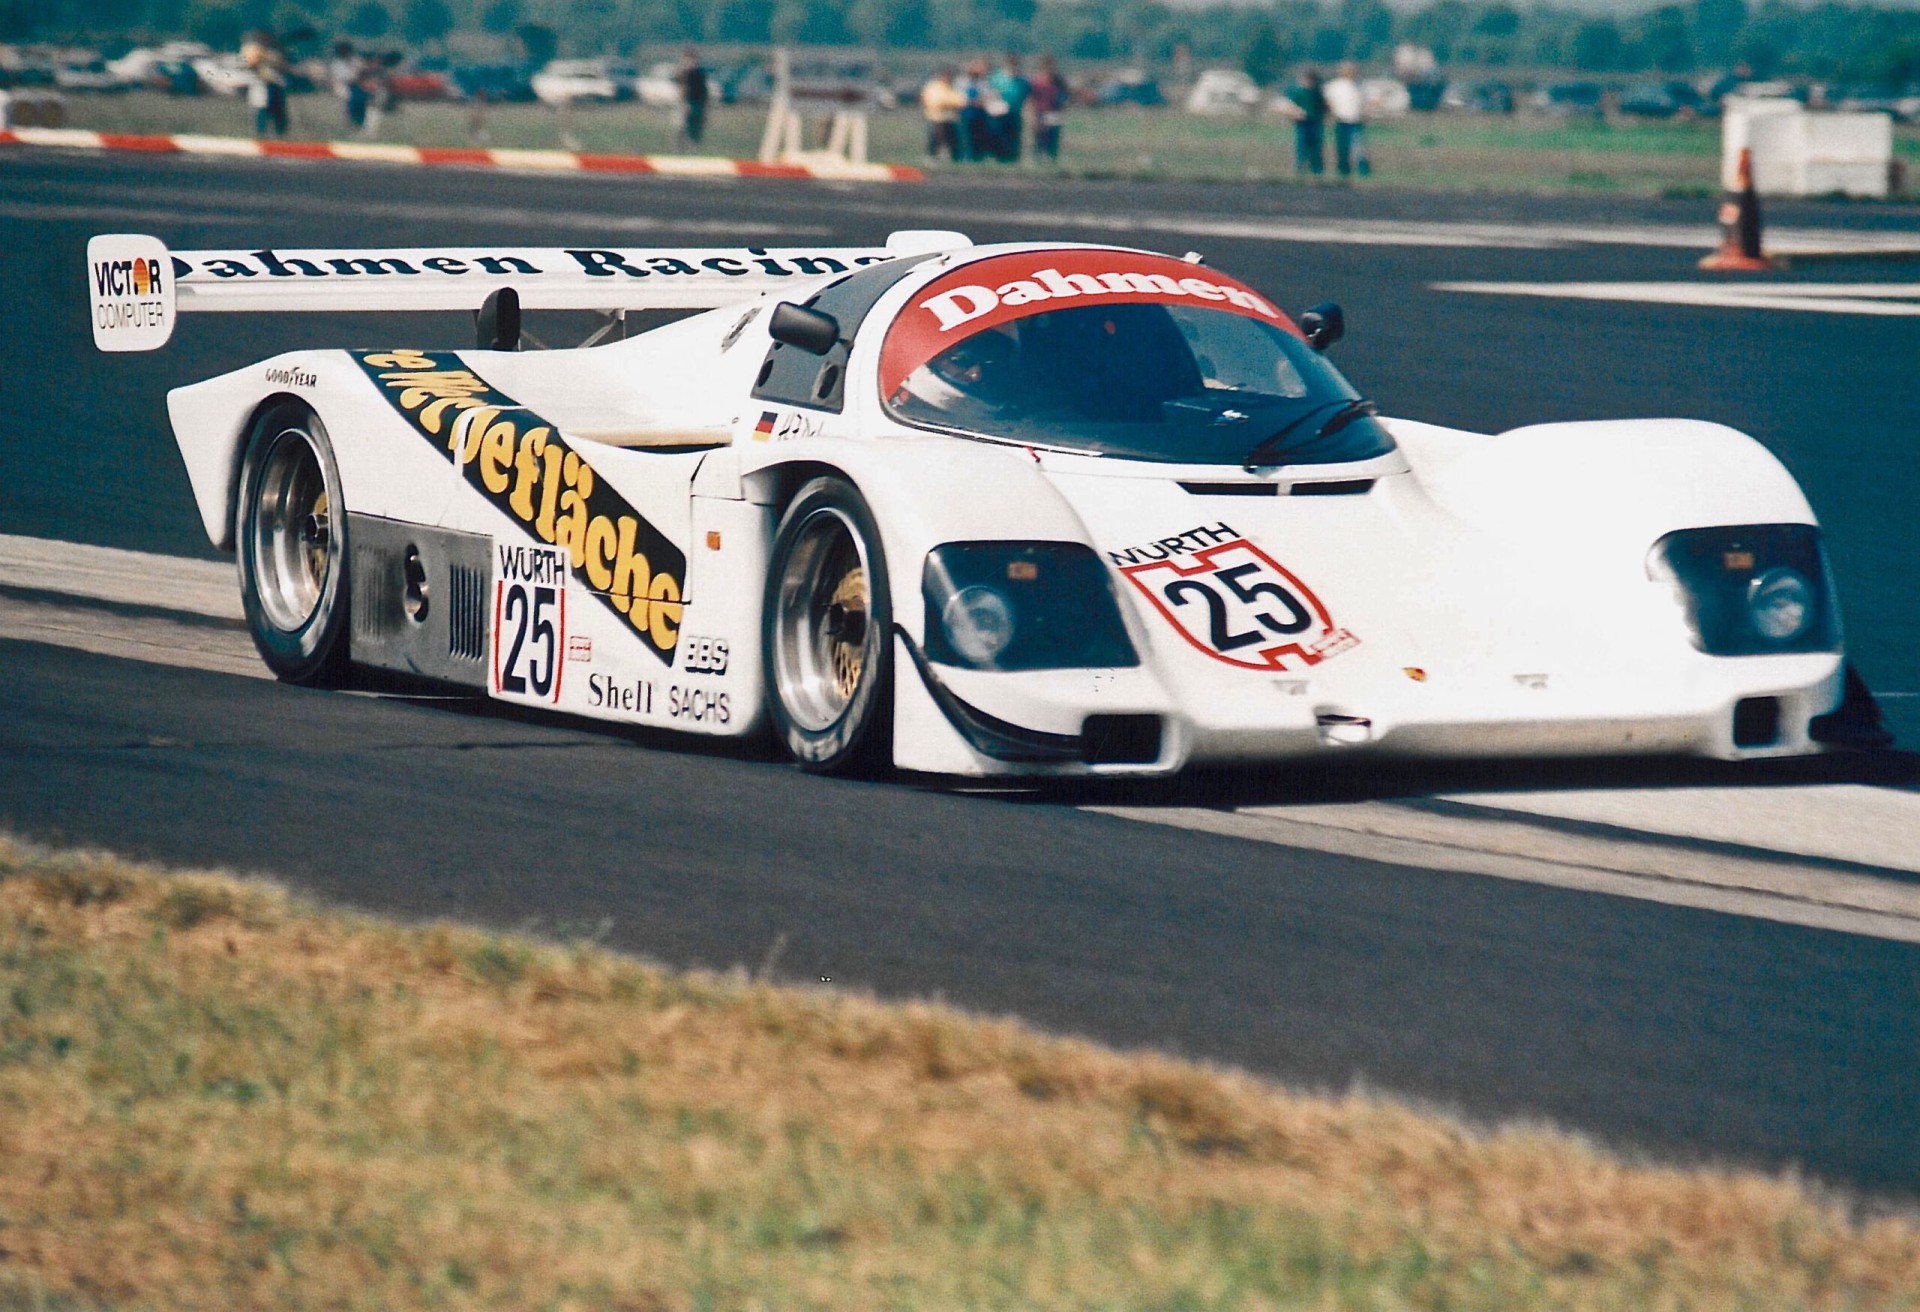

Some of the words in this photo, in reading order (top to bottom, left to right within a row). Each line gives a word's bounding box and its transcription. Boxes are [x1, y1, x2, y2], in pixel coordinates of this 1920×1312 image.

[94, 257, 162, 296] VICTOR
[171, 250, 543, 279] ahmen
[97, 302, 165, 329] COMPUTER
[919, 268, 1279, 332] Dahmen
[499, 544, 566, 587] WÜRTH
[1163, 562, 1312, 652] 25
[502, 584, 555, 697] 25
[684, 634, 730, 676] BBS
[588, 672, 652, 714] Shell
[669, 685, 731, 724] SACHS
